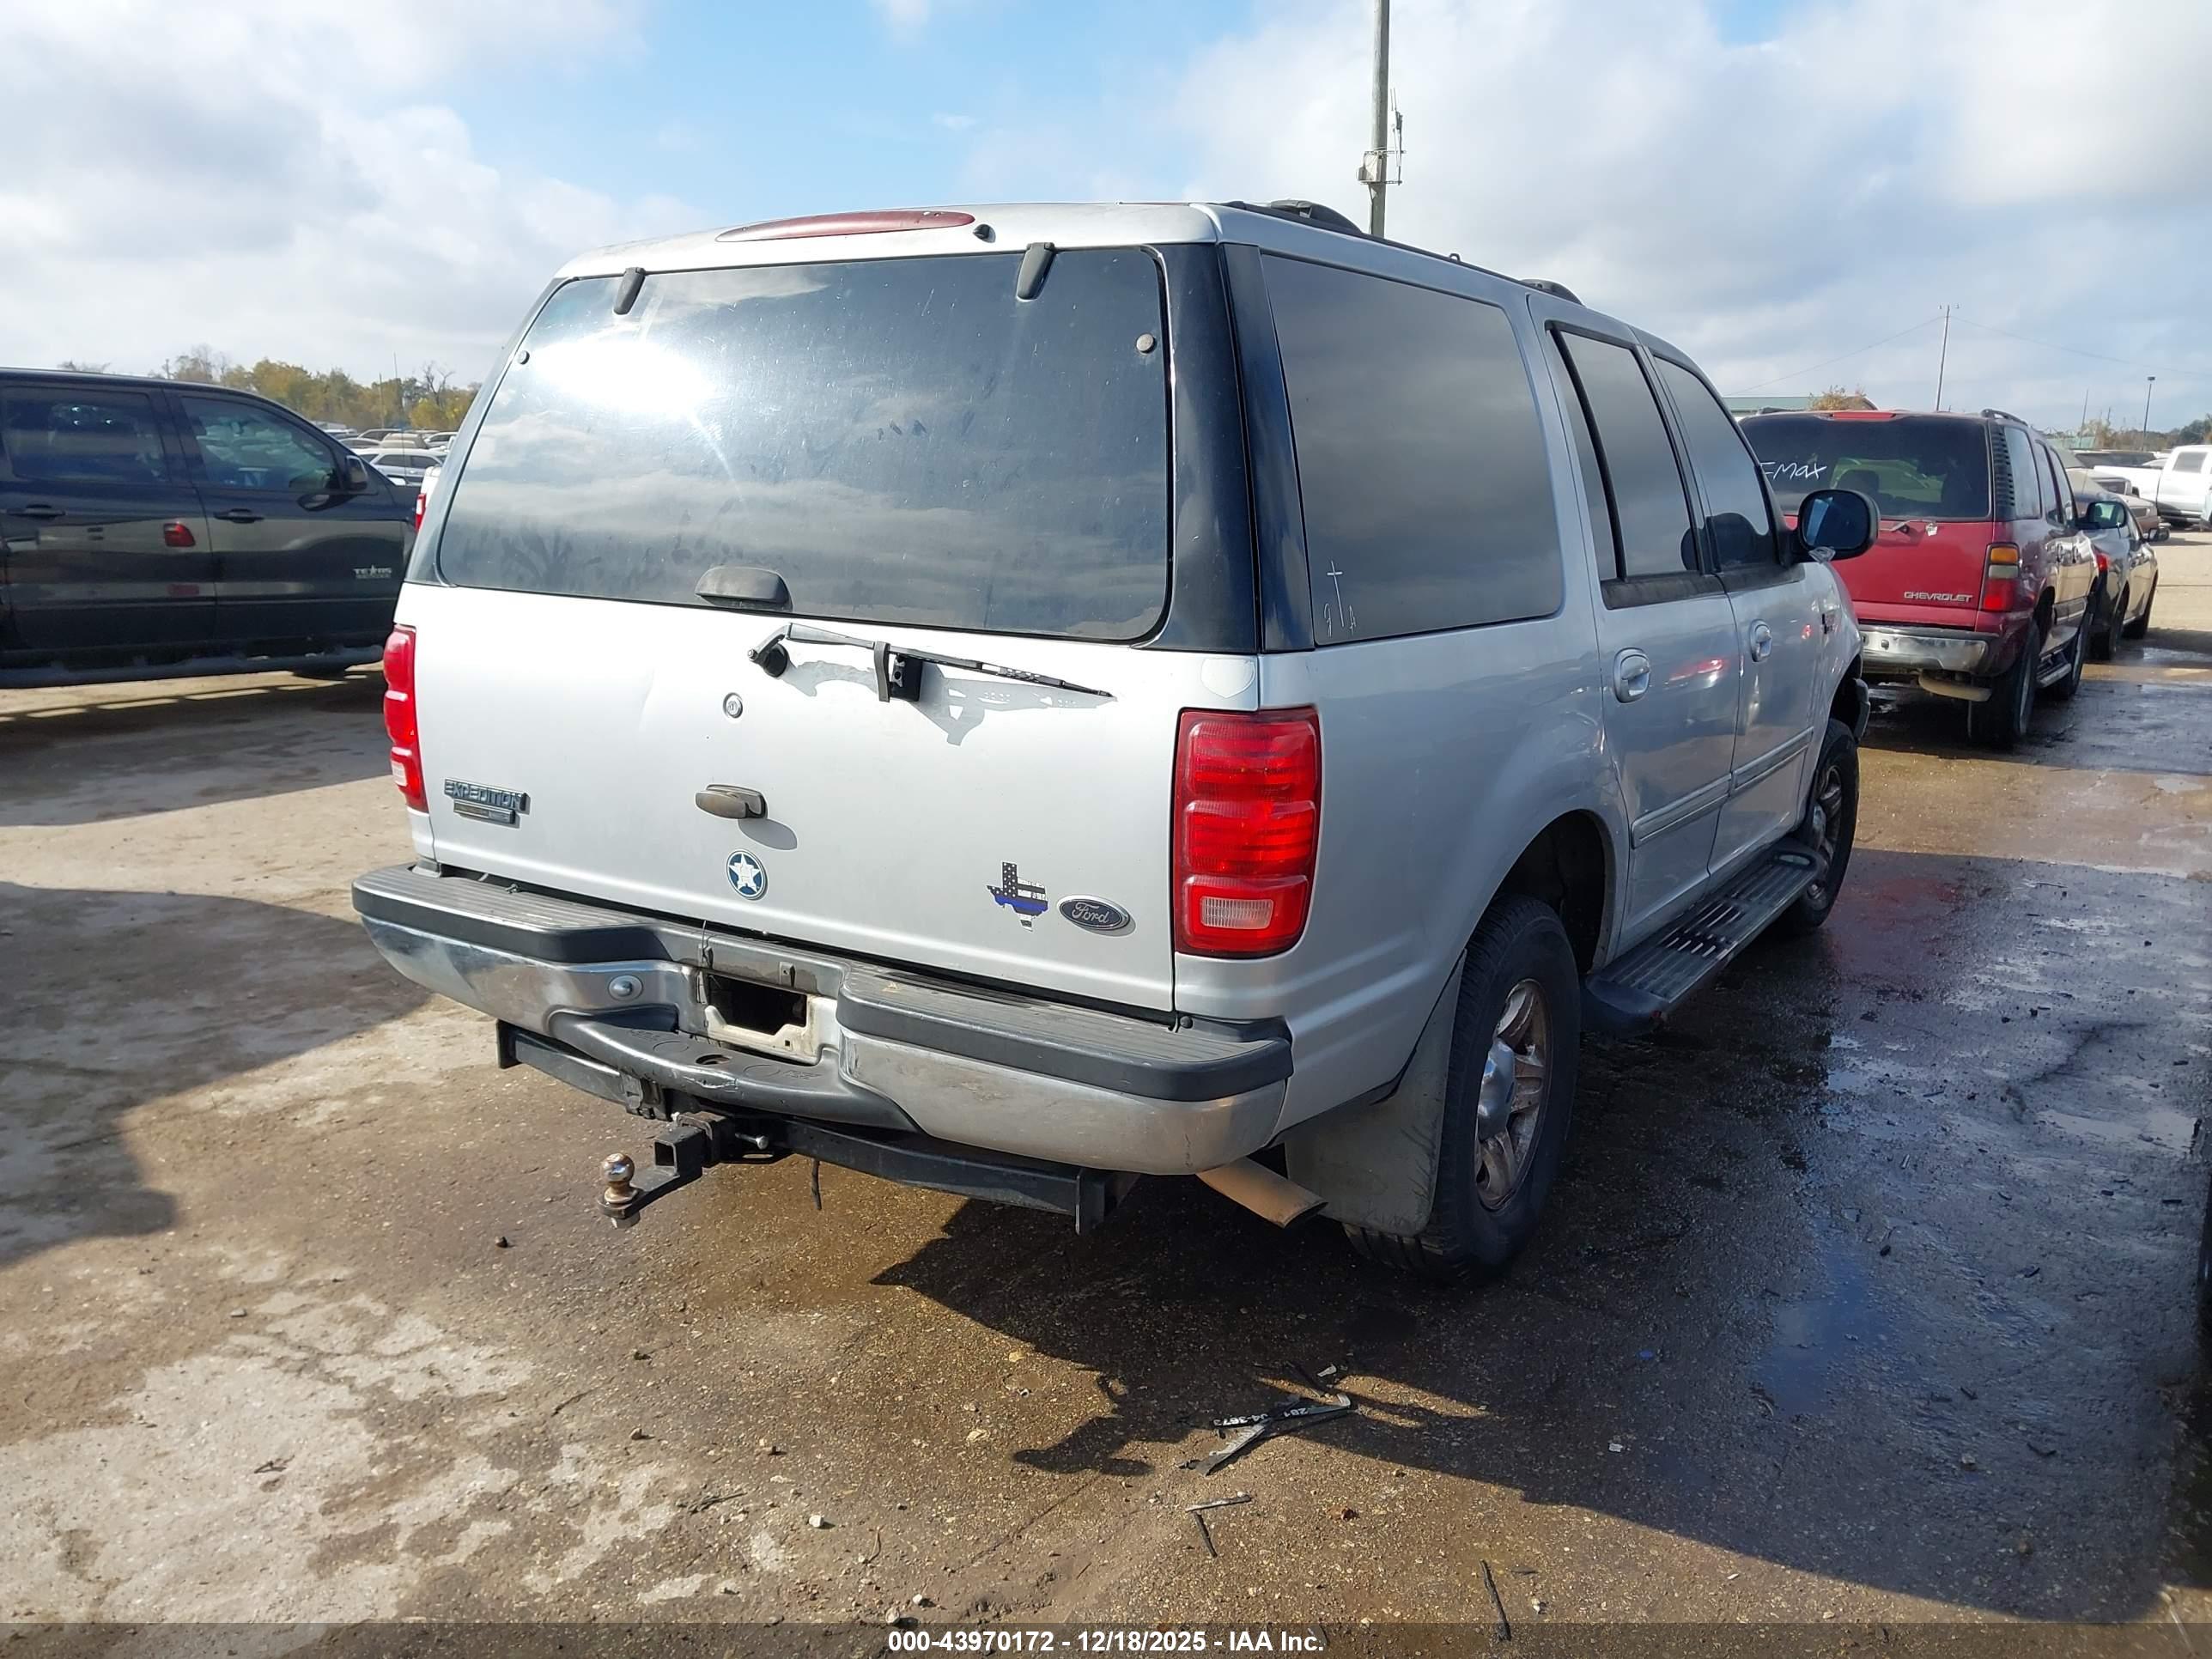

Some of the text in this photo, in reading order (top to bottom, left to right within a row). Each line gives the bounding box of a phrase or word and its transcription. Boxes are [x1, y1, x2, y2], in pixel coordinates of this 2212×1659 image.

[1904, 591, 1973, 603] CHEVROLET
[445, 780, 521, 809] EXPEDITION
[1071, 902, 1109, 924] Ford
